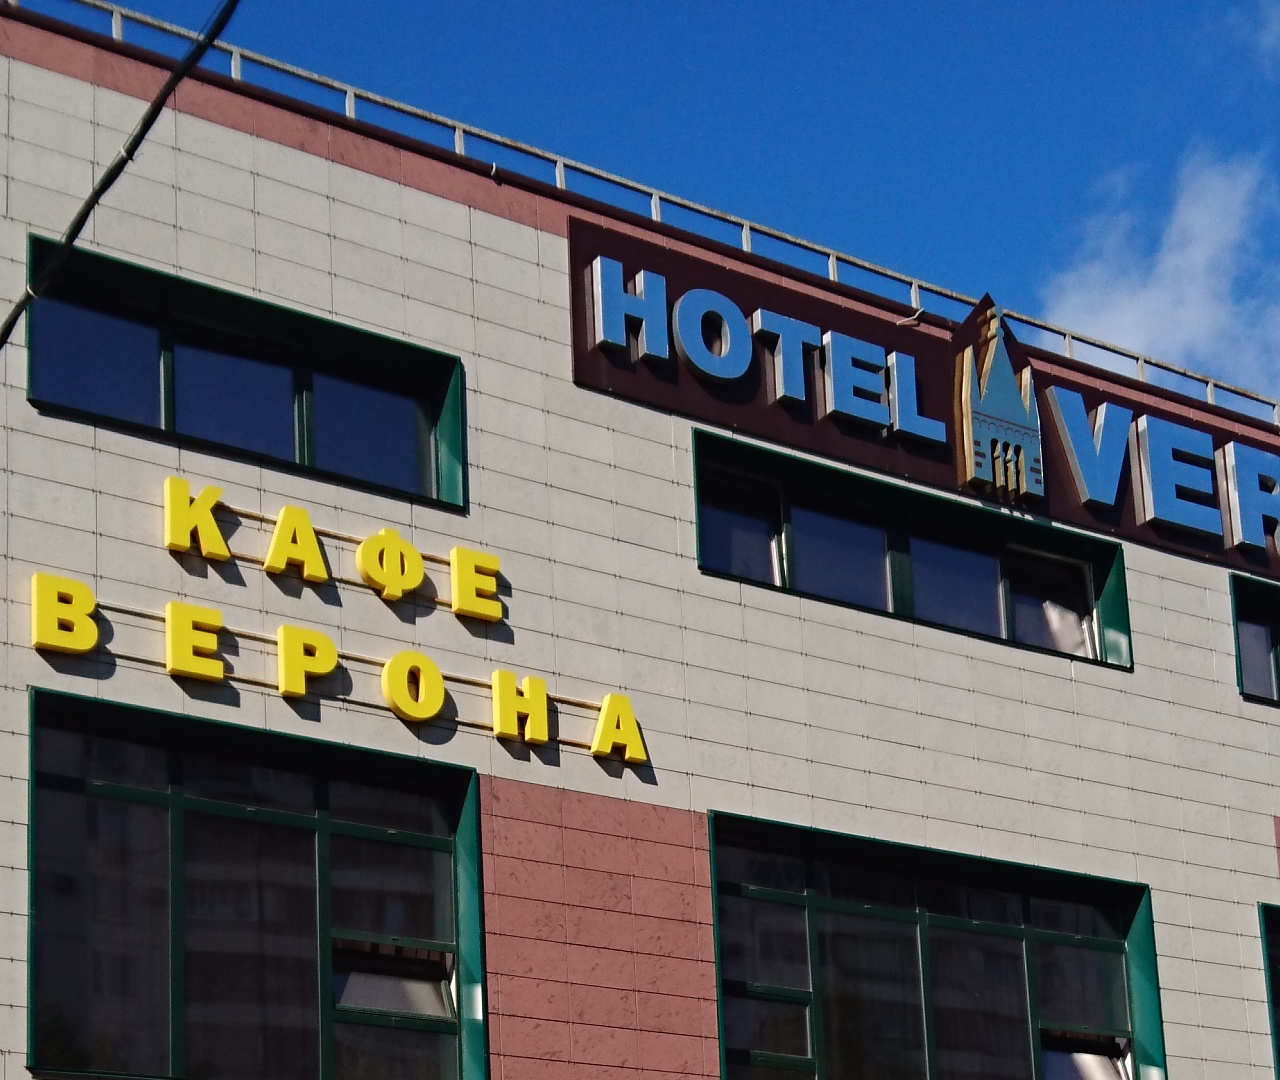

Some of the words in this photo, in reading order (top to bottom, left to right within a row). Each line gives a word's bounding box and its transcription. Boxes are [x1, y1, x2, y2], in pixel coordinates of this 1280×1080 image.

[592, 255, 946, 444] HOTEL
[163, 476, 503, 622] КАФЕ
[31, 571, 648, 764] ВЕРОНА
